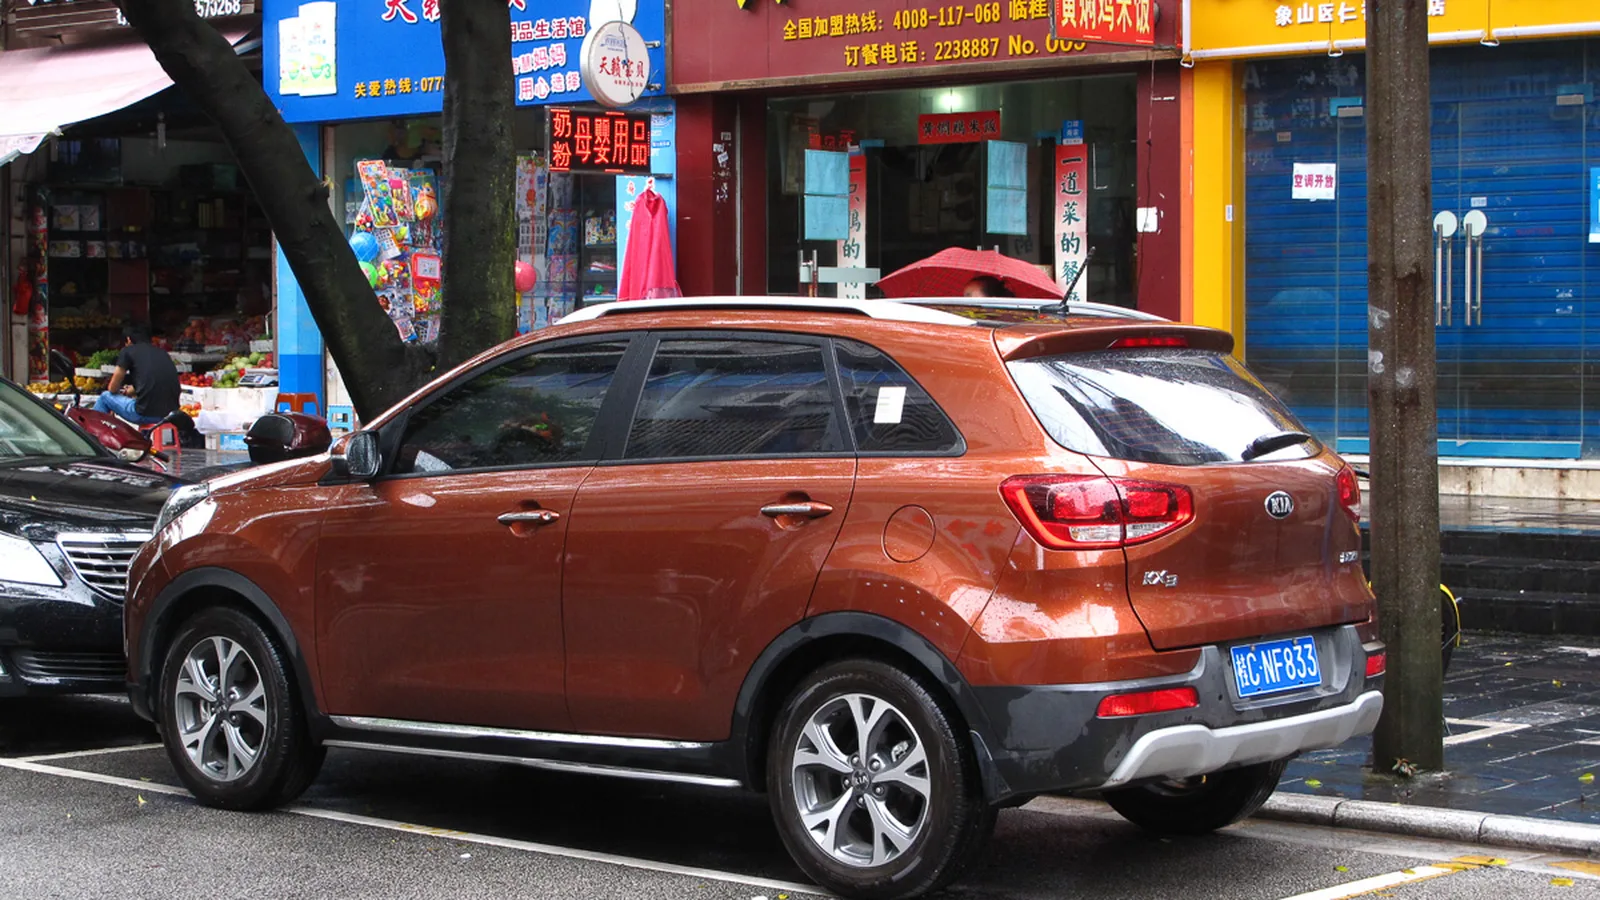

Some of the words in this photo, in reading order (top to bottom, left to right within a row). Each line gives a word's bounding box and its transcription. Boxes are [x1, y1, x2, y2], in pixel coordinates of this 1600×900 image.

[893, 3, 1000, 30] 4008-117-068
[1008, 0, 1050, 20] 临桂
[1275, 2, 1366, 26] 象山区仁
[934, 37, 999, 62] 2238887
[1008, 34, 1039, 55] No.
[354, 76, 445, 99] 关爱热线:077
[1293, 173, 1335, 189] 空调开放
[1270, 496, 1292, 513] KIA
[1142, 570, 1178, 587] KX3
